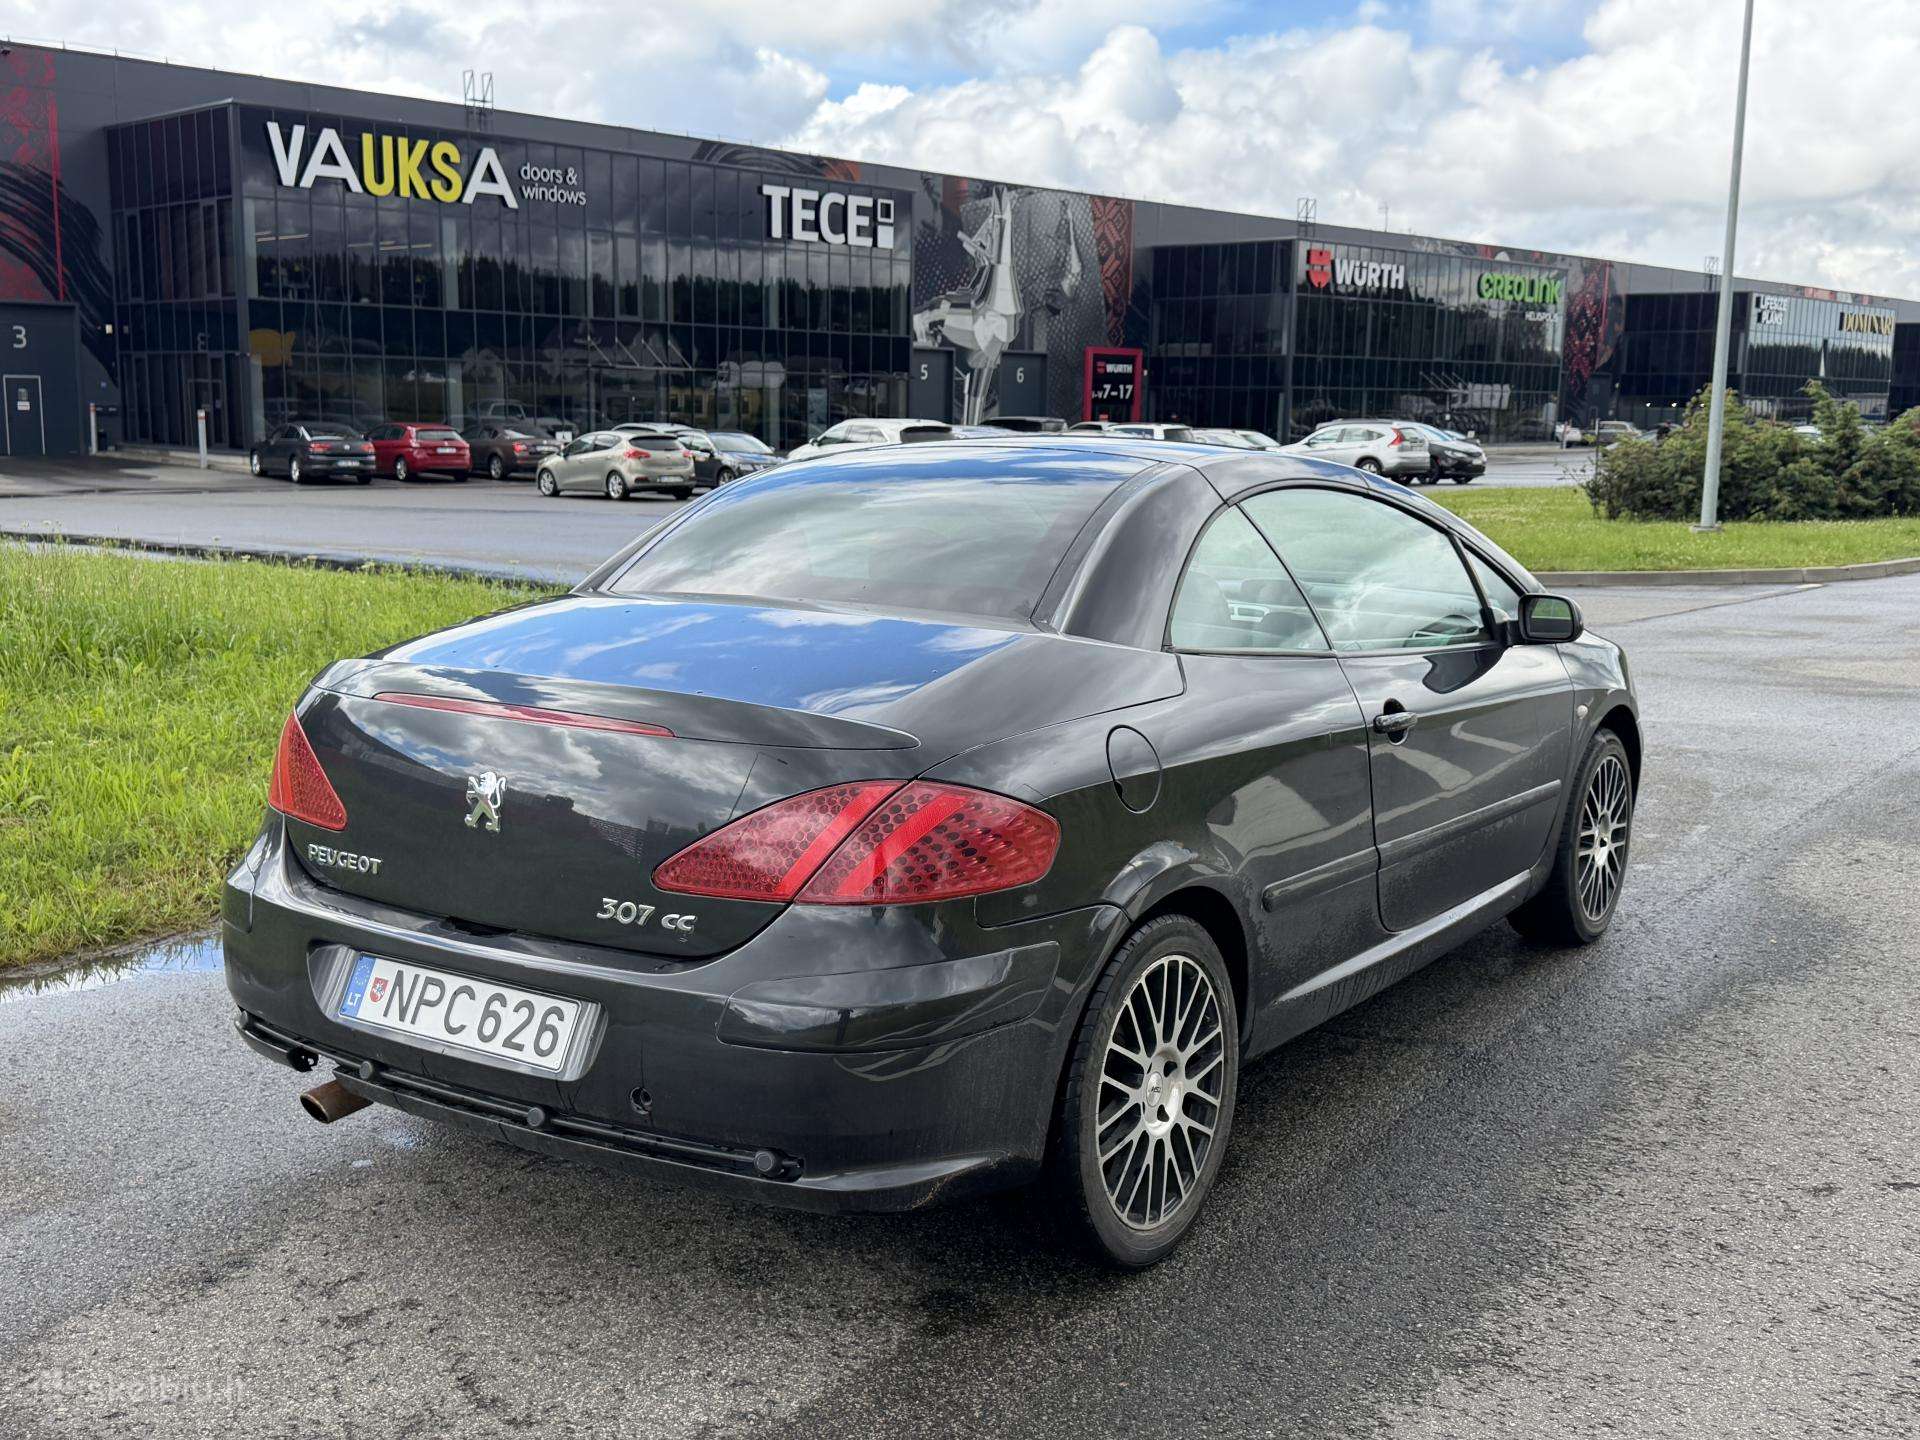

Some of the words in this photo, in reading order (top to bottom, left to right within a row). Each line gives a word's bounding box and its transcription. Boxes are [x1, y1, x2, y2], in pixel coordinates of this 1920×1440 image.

[266, 121, 519, 209] VAUKSA
[520, 161, 562, 185] doors
[565, 168, 578, 186] &
[521, 184, 587, 206] windows
[762, 184, 874, 247] TECE
[1334, 257, 1405, 290] WÜRTH
[12, 325, 27, 348] 3
[920, 363, 928, 381] 5
[1016, 366, 1025, 384] 6
[308, 843, 382, 875] PEUGEOT
[596, 897, 656, 926] 307
[347, 991, 361, 1007] LT
